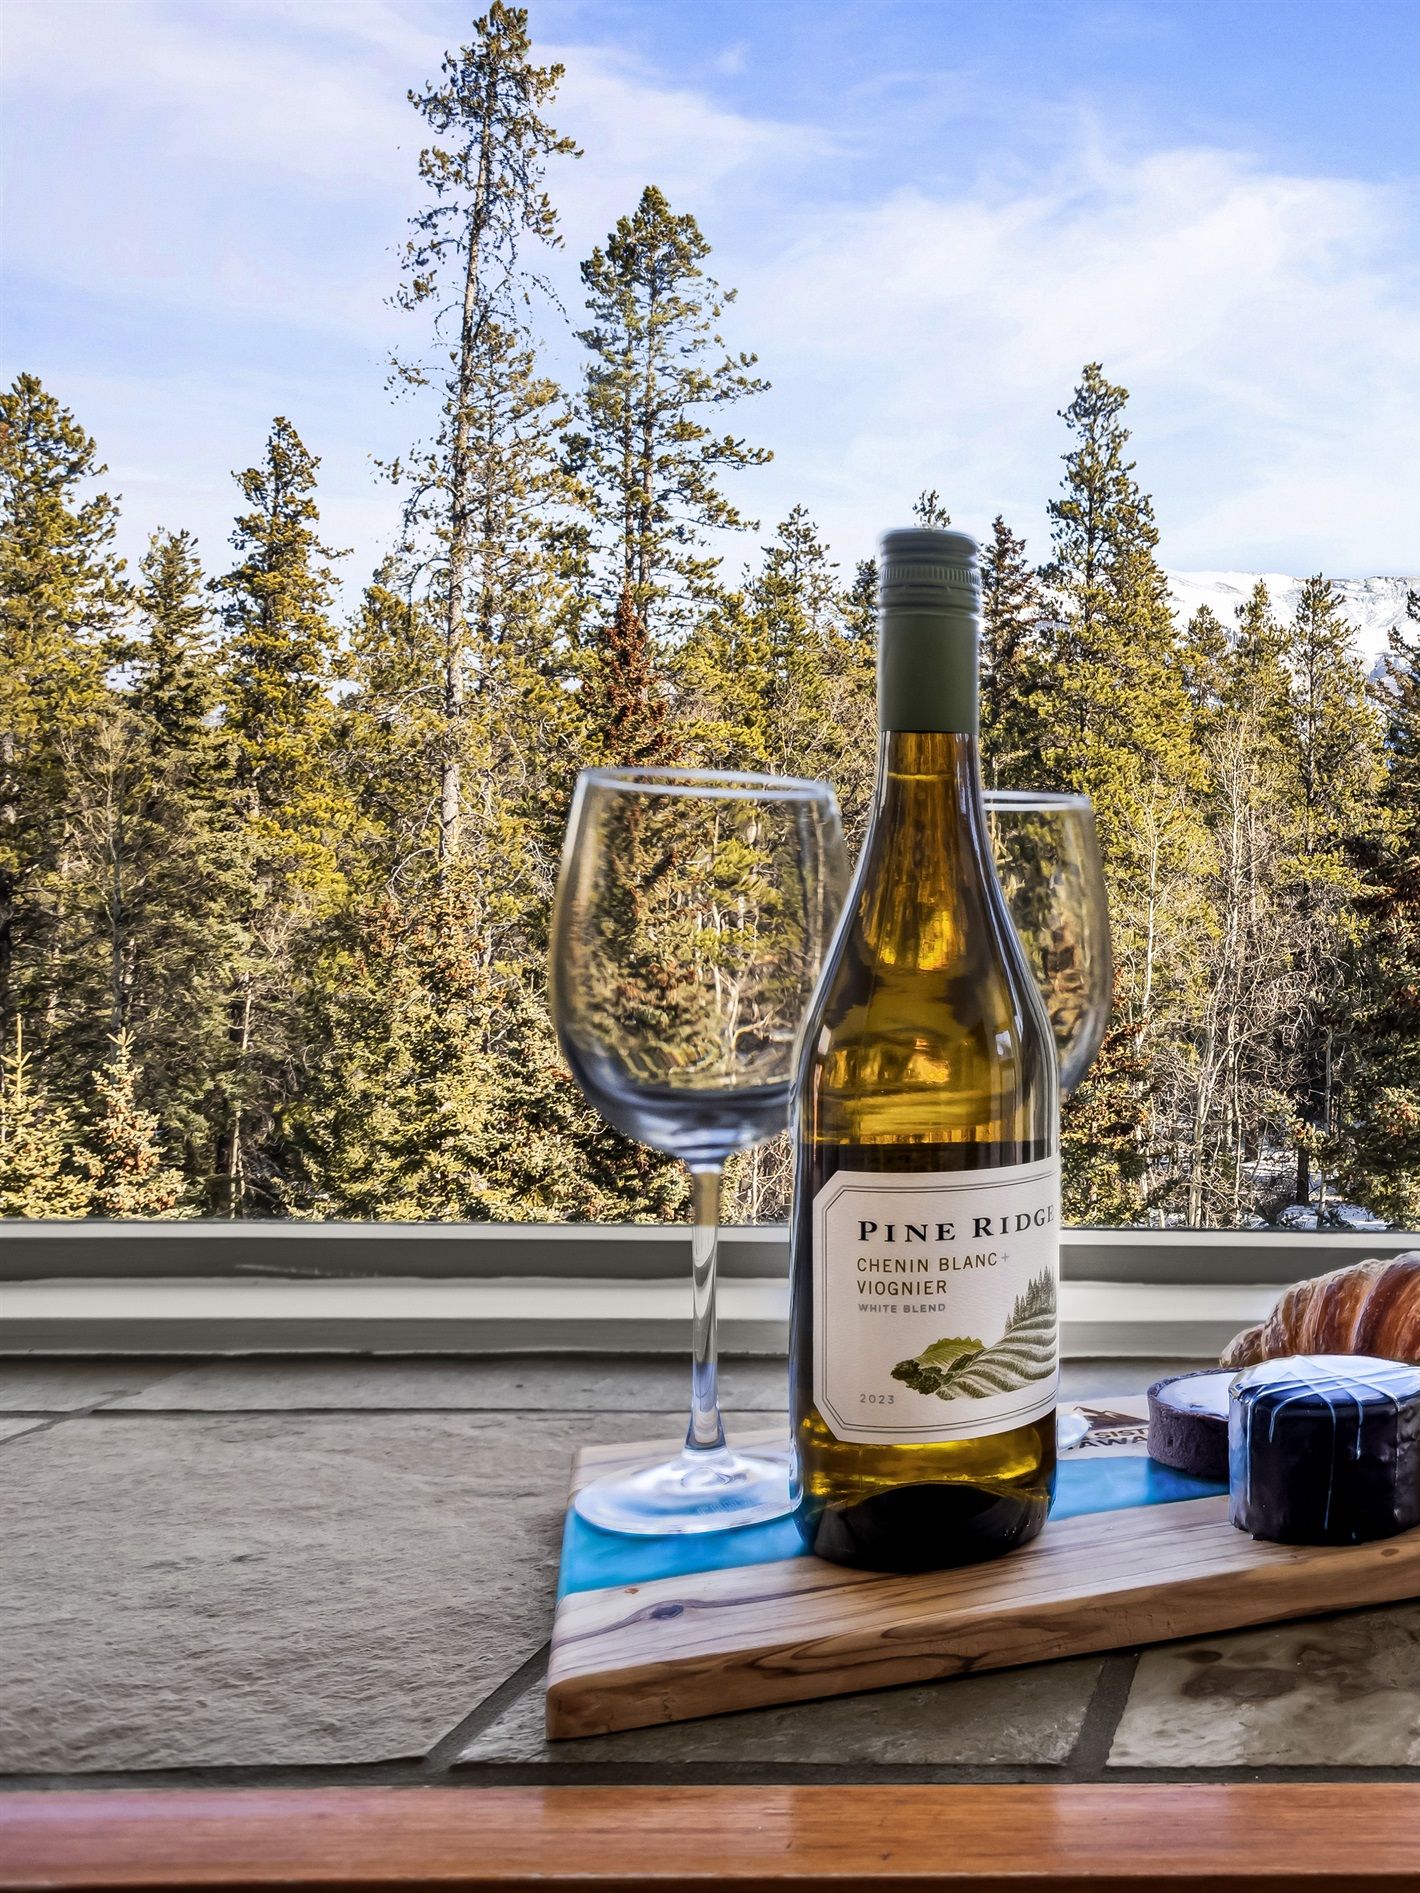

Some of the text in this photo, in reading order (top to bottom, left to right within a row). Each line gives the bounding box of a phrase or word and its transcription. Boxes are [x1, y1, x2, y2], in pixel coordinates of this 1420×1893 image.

[857, 1204, 1055, 1243] PINE RIDGE
[856, 1257, 930, 1273] CHENIN
[938, 1252, 998, 1272] BLANC
[856, 1279, 948, 1296] VIOGNIER
[858, 1303, 946, 1314] WHITE BLEND
[859, 1393, 895, 1405] 2023
[1094, 1427, 1149, 1439] SIST
